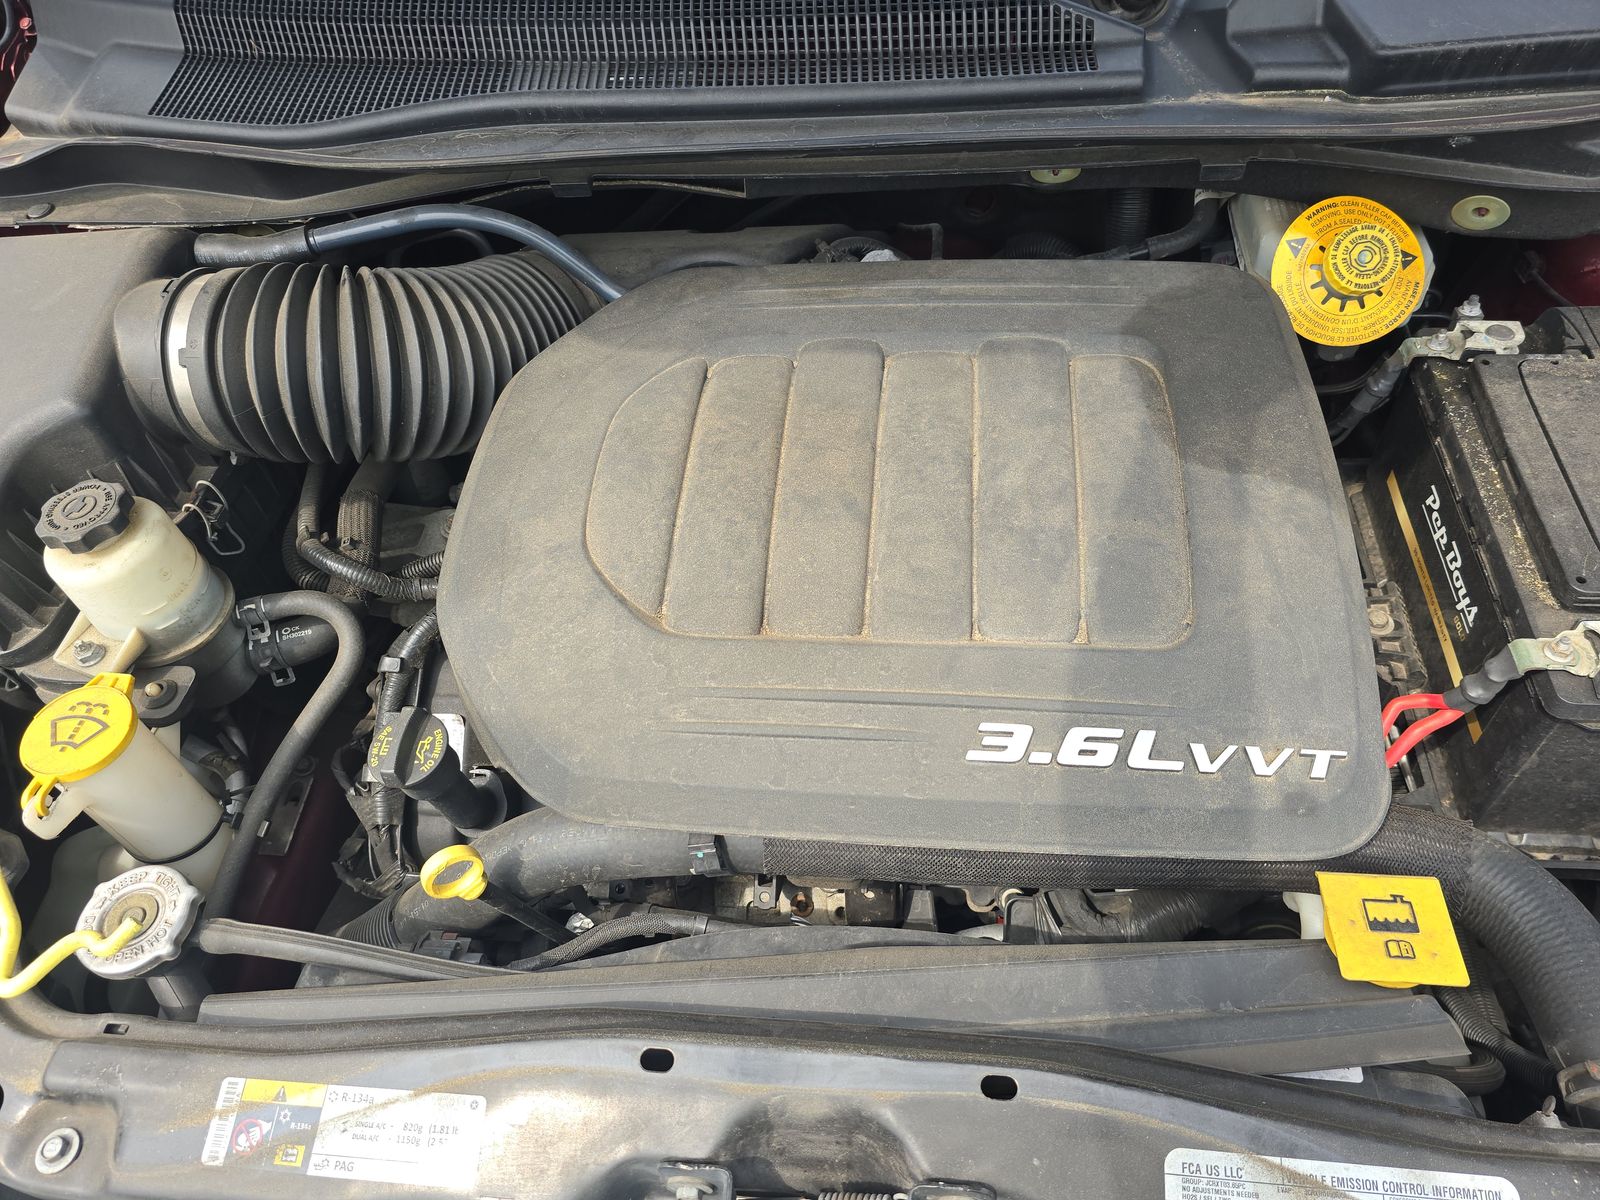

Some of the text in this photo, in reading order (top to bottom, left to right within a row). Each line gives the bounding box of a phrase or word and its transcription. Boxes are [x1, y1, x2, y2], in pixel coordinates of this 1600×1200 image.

[1305, 202, 1340, 221] WARNING:
[1360, 202, 1380, 214] FILLER
[1380, 210, 1392, 220] CAP
[1392, 218, 1410, 238] BEFORE
[1356, 210, 1374, 219] ONLY
[1373, 215, 1386, 225] DOT
[1389, 227, 1404, 244] FLUID
[1315, 222, 1334, 236] FROM
[1349, 234, 1368, 246] BEFORE
[1396, 276, 1404, 290] DOT
[1402, 280, 1412, 300] AVANT
[1410, 282, 1420, 299] MISE
[1290, 296, 1298, 306] DU
[1396, 300, 1404, 310] DE
[1404, 300, 1414, 309] EN
[1306, 304, 1340, 324] CONTENANT
[1362, 296, 1396, 322] PROVENANT
[1388, 308, 1397, 316] LE
[1295, 306, 1330, 331] UNIQUEMENT
[1296, 320, 1305, 330] DE
[1341, 318, 1359, 326] D'UN
[1305, 326, 1335, 342] BOUCHON
[1346, 328, 1380, 342] NETTOYER
[1425, 484, 1478, 628] Pep Boys
[370, 725, 392, 768] SAE 5W-20
[420, 728, 443, 772] ENGINE OIL
[965, 722, 1348, 780] 3.6L VVT
[106, 872, 180, 901] KEEP TIGHT
[105, 944, 145, 963] OPEN
[147, 918, 173, 947] HOT
[342, 1092, 374, 1104] R-134a
[354, 1120, 374, 1129] SINGLE
[403, 1122, 422, 1134] 820g
[352, 1133, 366, 1141] DUAL
[396, 1135, 420, 1147] 1150g
[334, 1160, 354, 1172] PAG
[1182, 1162, 1243, 1179] FCA US LLC
[1182, 1177, 1204, 1186] GROUP:
[1331, 1176, 1378, 1191] EMISSION
[1382, 1180, 1428, 1196] CONTROL
[1432, 1185, 1502, 1200] INFORMATION
[1192, 1186, 1234, 1196] ADJUSTMENTS
[1236, 1190, 1260, 1198] NEEDED
